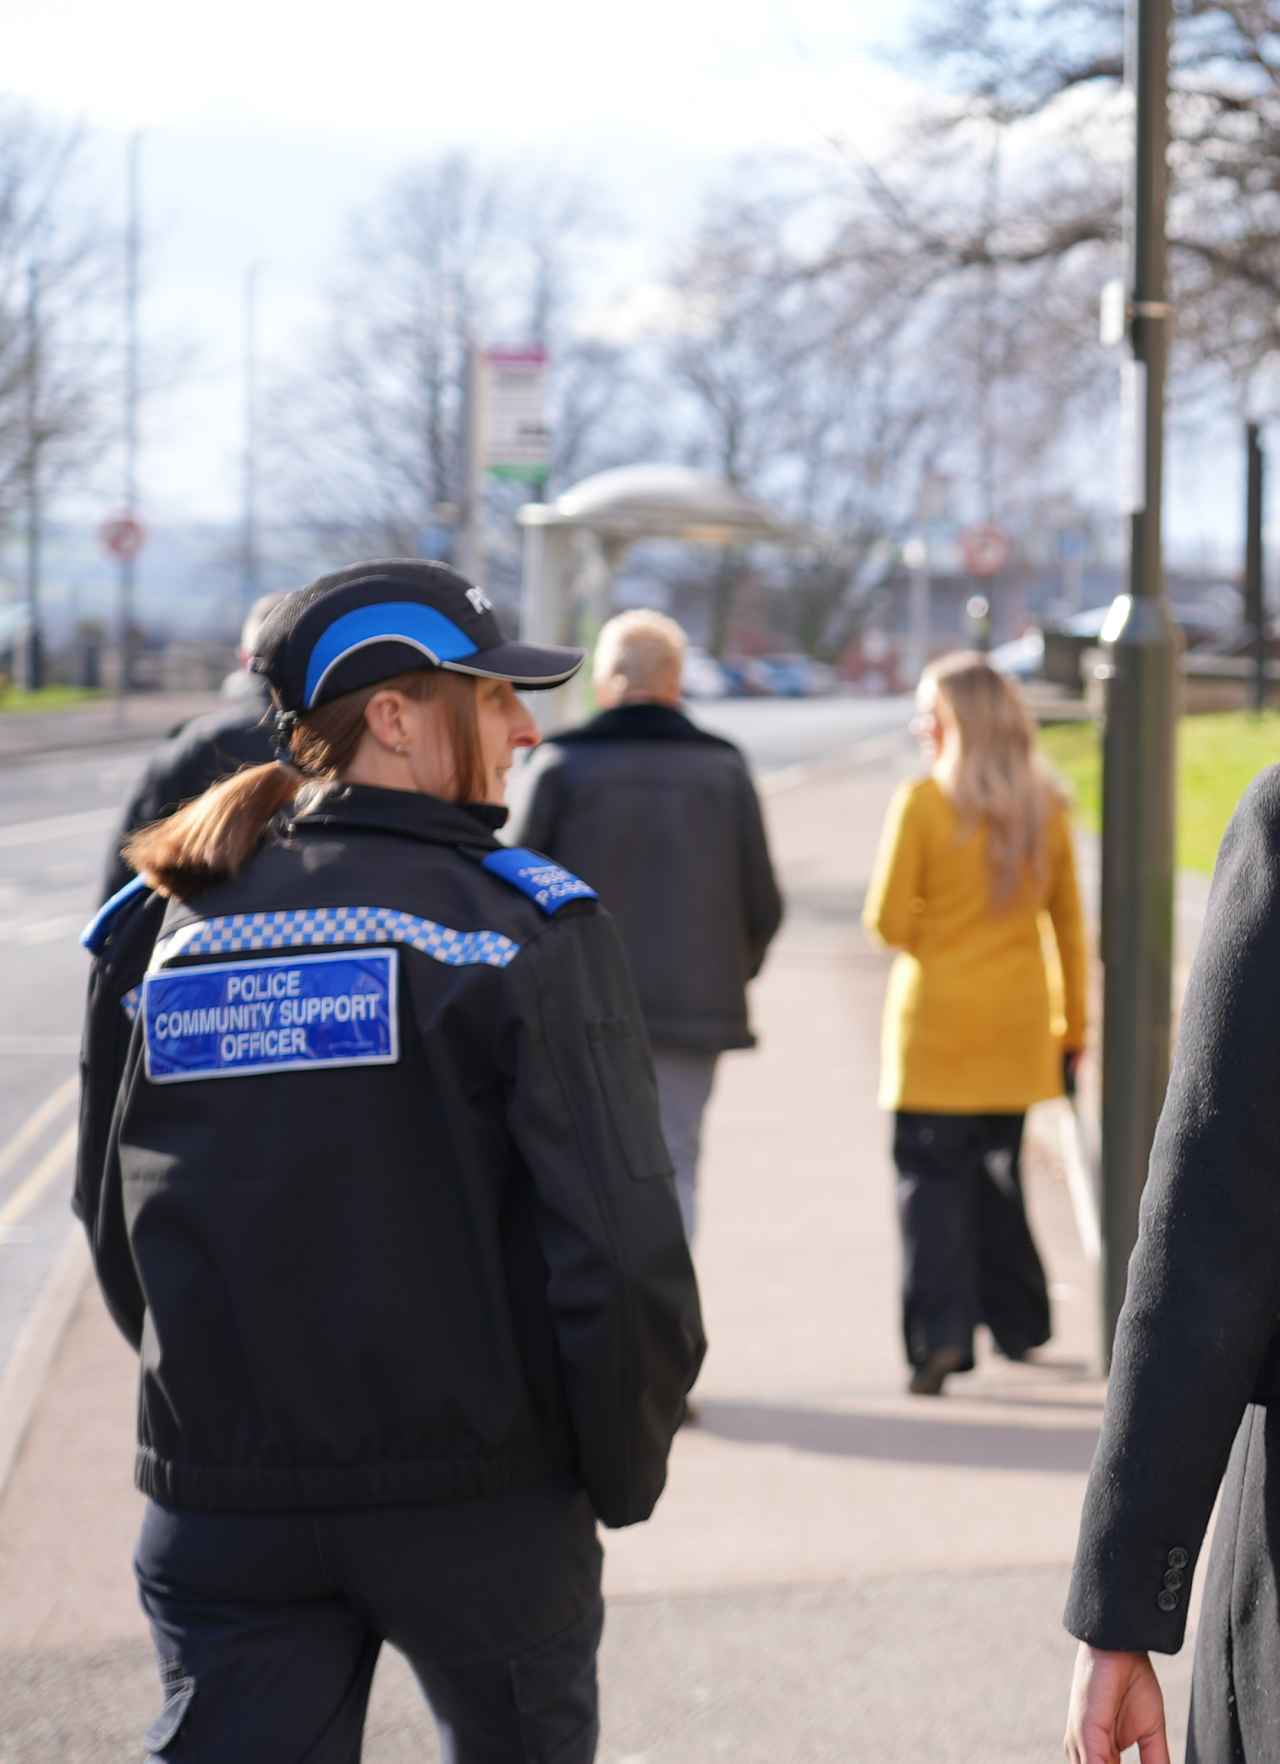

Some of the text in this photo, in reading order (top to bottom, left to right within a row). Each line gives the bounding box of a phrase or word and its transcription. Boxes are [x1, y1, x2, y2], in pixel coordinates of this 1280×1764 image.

[226, 970, 302, 1002] POLICE
[154, 993, 380, 1040] COMMUNITY SUPPORT
[220, 1027, 306, 1062] OFFICER
